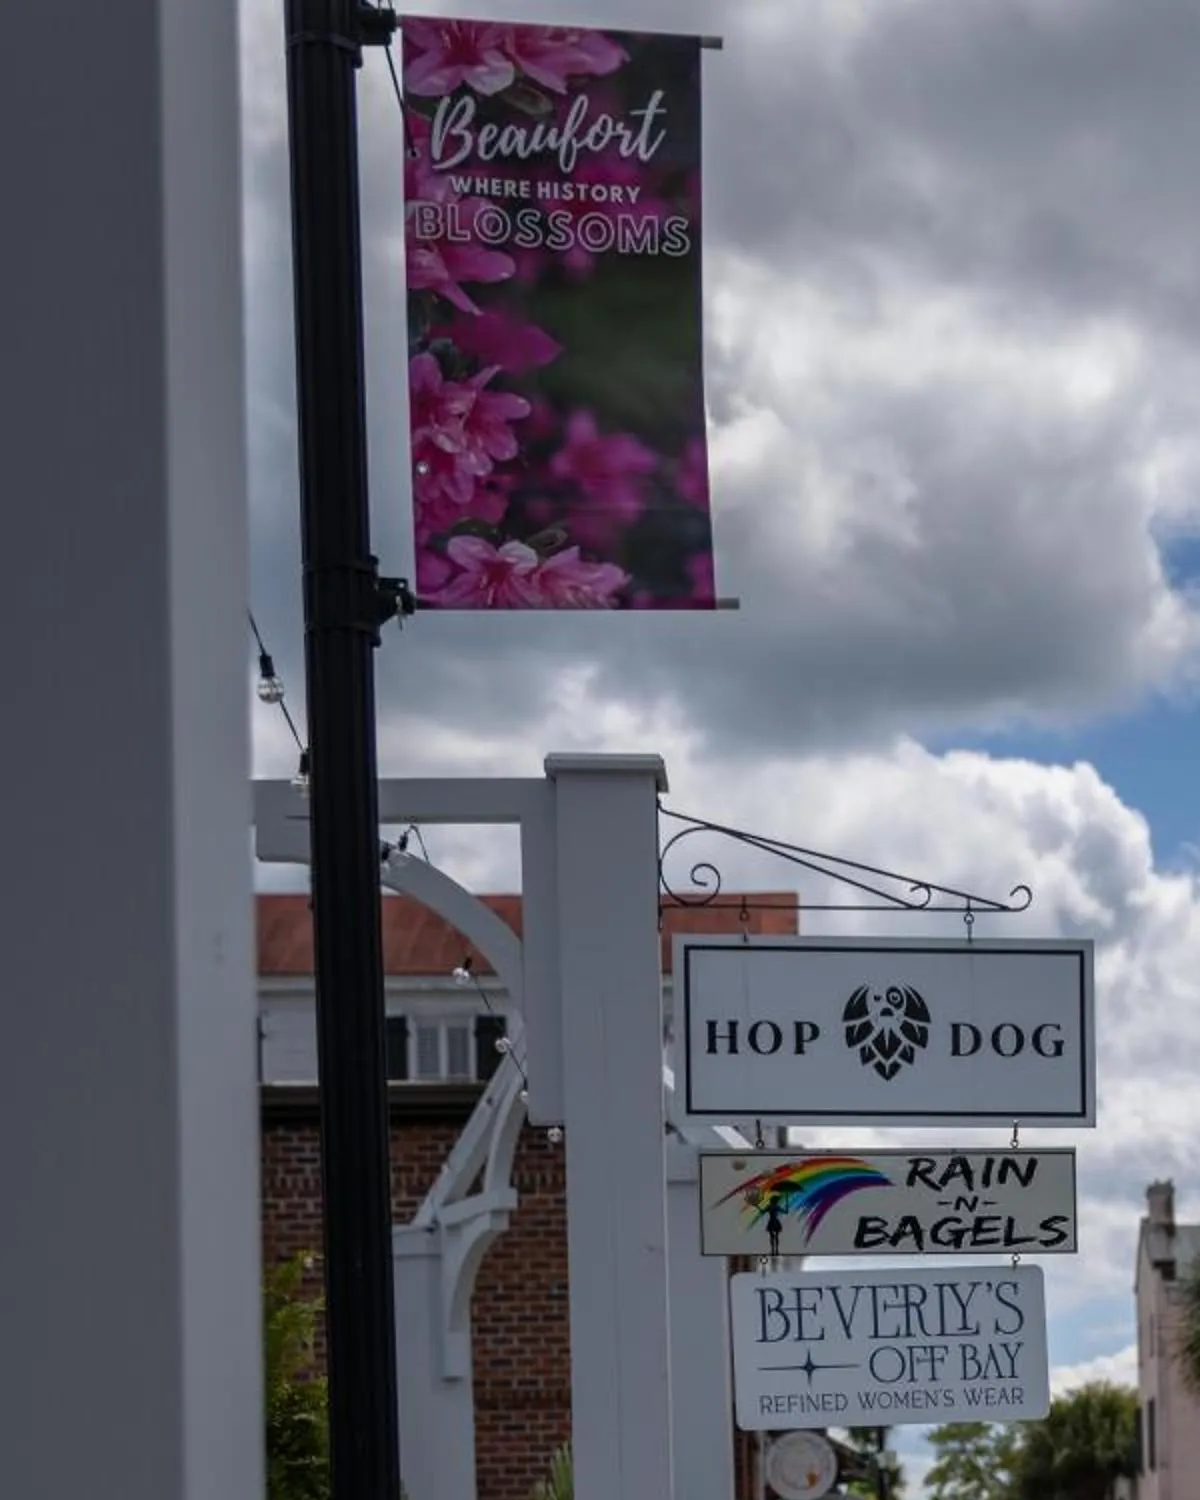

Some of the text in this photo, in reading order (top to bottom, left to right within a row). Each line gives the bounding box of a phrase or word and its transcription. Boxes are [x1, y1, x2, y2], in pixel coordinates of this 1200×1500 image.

[430, 89, 667, 173] Beaufort
[450, 175, 641, 204] WHERE HISTORY
[415, 202, 691, 256] BLOSSOMS
[706, 1020, 1065, 1058] HOP DOG
[906, 1156, 1037, 1192] RAIN
[854, 1215, 1069, 1251] BAGELS
[755, 1281, 1025, 1343] BEVERLY'S
[868, 1342, 1025, 1384] OFF BAY
[761, 1387, 1024, 1415] REFINED WOMEN'S WEAR
